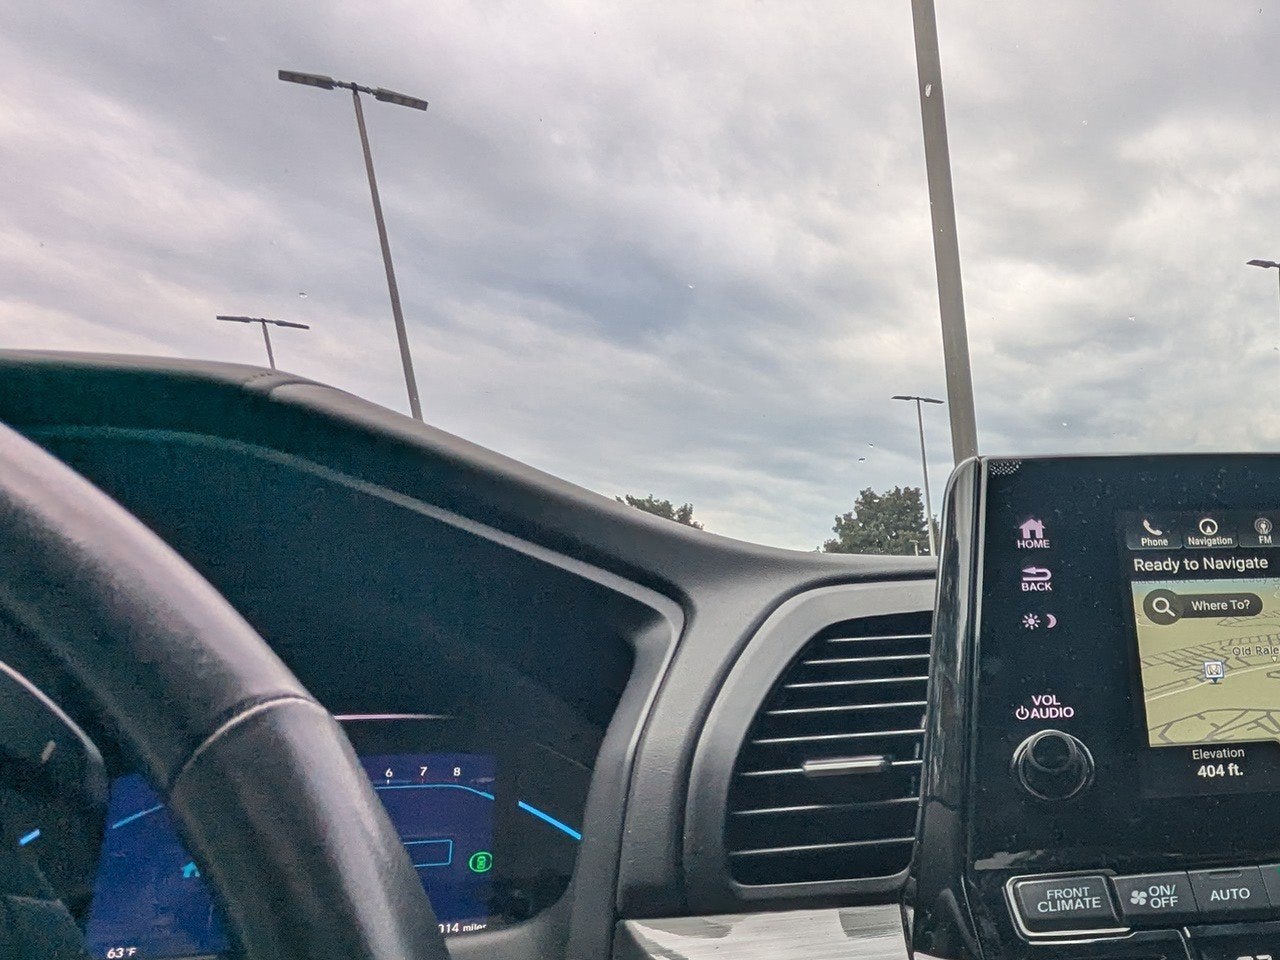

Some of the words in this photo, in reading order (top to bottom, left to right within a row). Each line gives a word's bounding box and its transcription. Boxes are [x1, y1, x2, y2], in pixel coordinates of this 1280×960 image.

[1016, 538, 1051, 550] HOME
[1140, 536, 1169, 549] Phone
[1187, 535, 1234, 548] Navigation
[1258, 534, 1273, 545] FM
[1133, 557, 1180, 574] Ready
[1182, 557, 1200, 571] to
[1202, 555, 1269, 573] Navigate
[1020, 581, 1053, 592] BACK
[1191, 599, 1228, 612] Where
[1230, 598, 1251, 611] To?
[1232, 645, 1252, 656] Old
[1031, 694, 1061, 706] VOL
[1030, 706, 1075, 719] AUDIO
[1191, 746, 1245, 760] Elevation
[385, 768, 393, 778] 6
[420, 766, 428, 776] 7
[453, 767, 461, 776] 8
[1197, 764, 1225, 778] 404
[1227, 763, 1245, 777] ft.
[1046, 886, 1091, 899] FRONT
[1148, 884, 1177, 898] ON/
[1210, 887, 1251, 902] AUTO
[1037, 897, 1102, 914] CLIMATE
[1151, 896, 1180, 910] OFF
